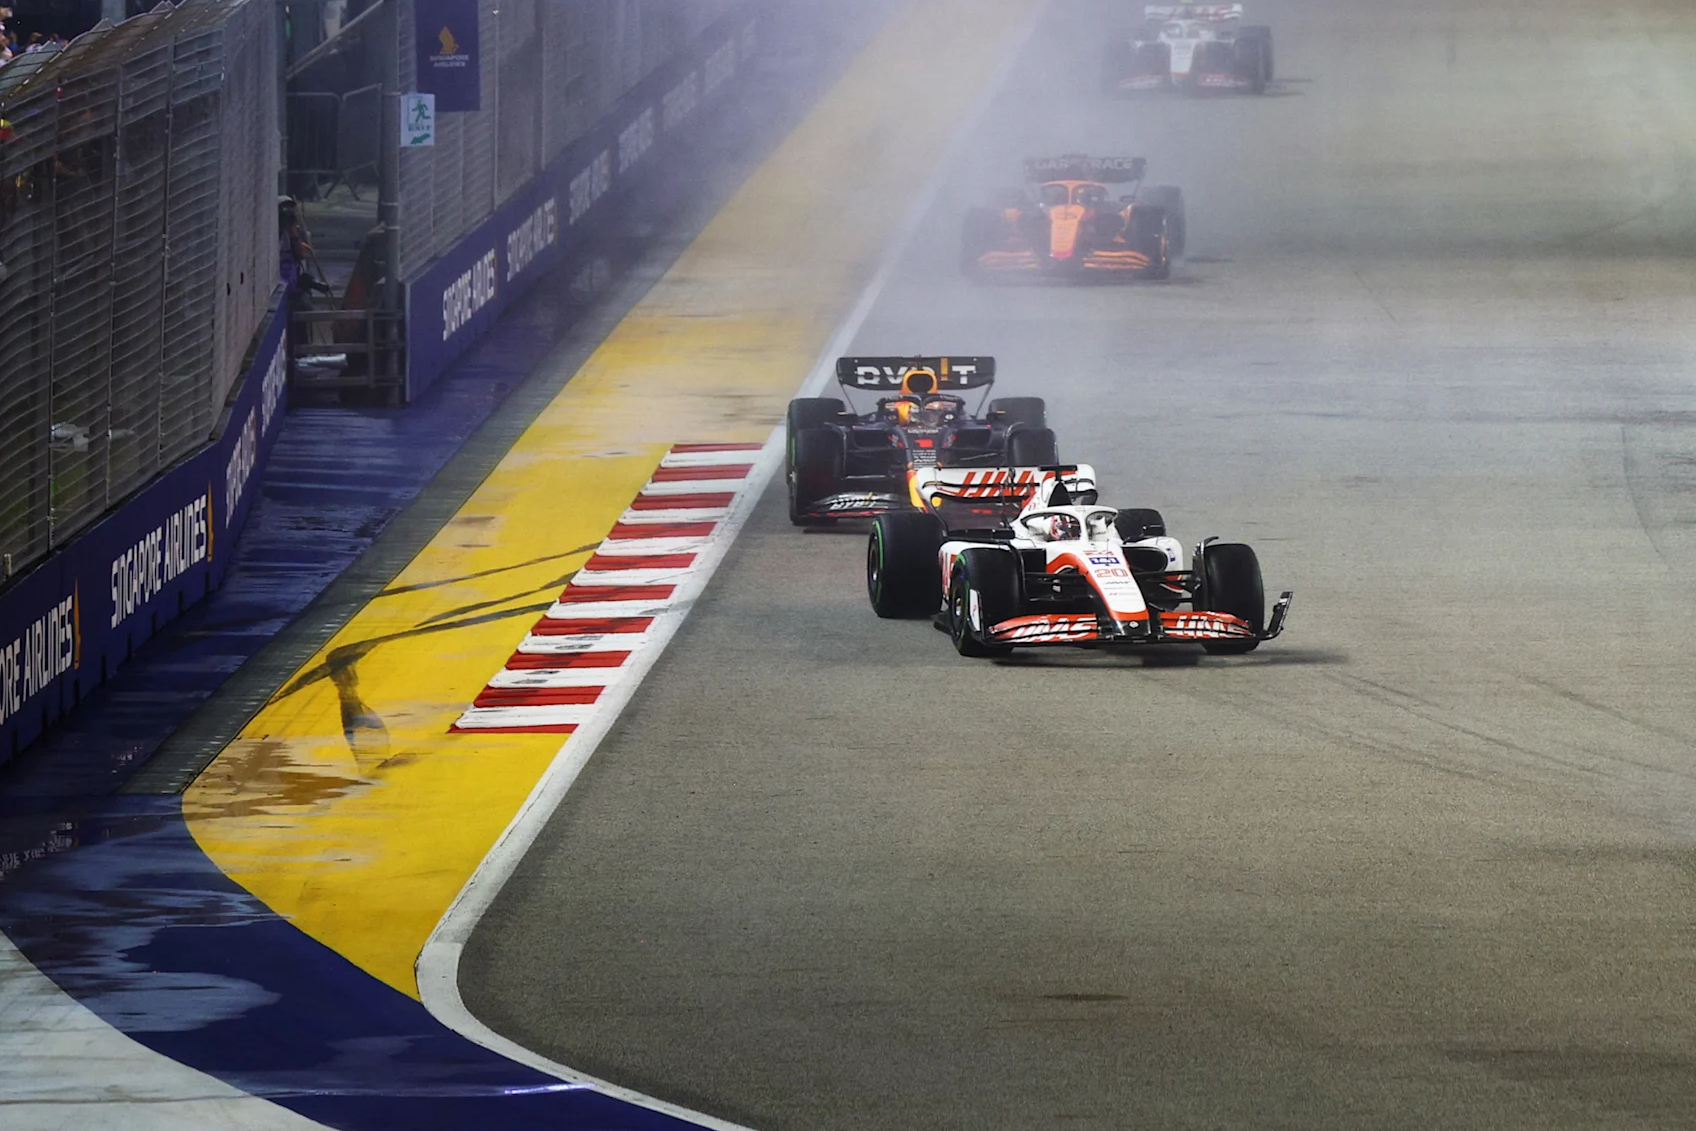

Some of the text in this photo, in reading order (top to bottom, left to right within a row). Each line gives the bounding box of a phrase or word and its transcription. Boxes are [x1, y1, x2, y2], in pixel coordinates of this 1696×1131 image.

[111, 494, 206, 629] SINGAPORE AIRLINES
[1094, 568, 1129, 578] 20
[23, 595, 72, 703] AIRLINES
